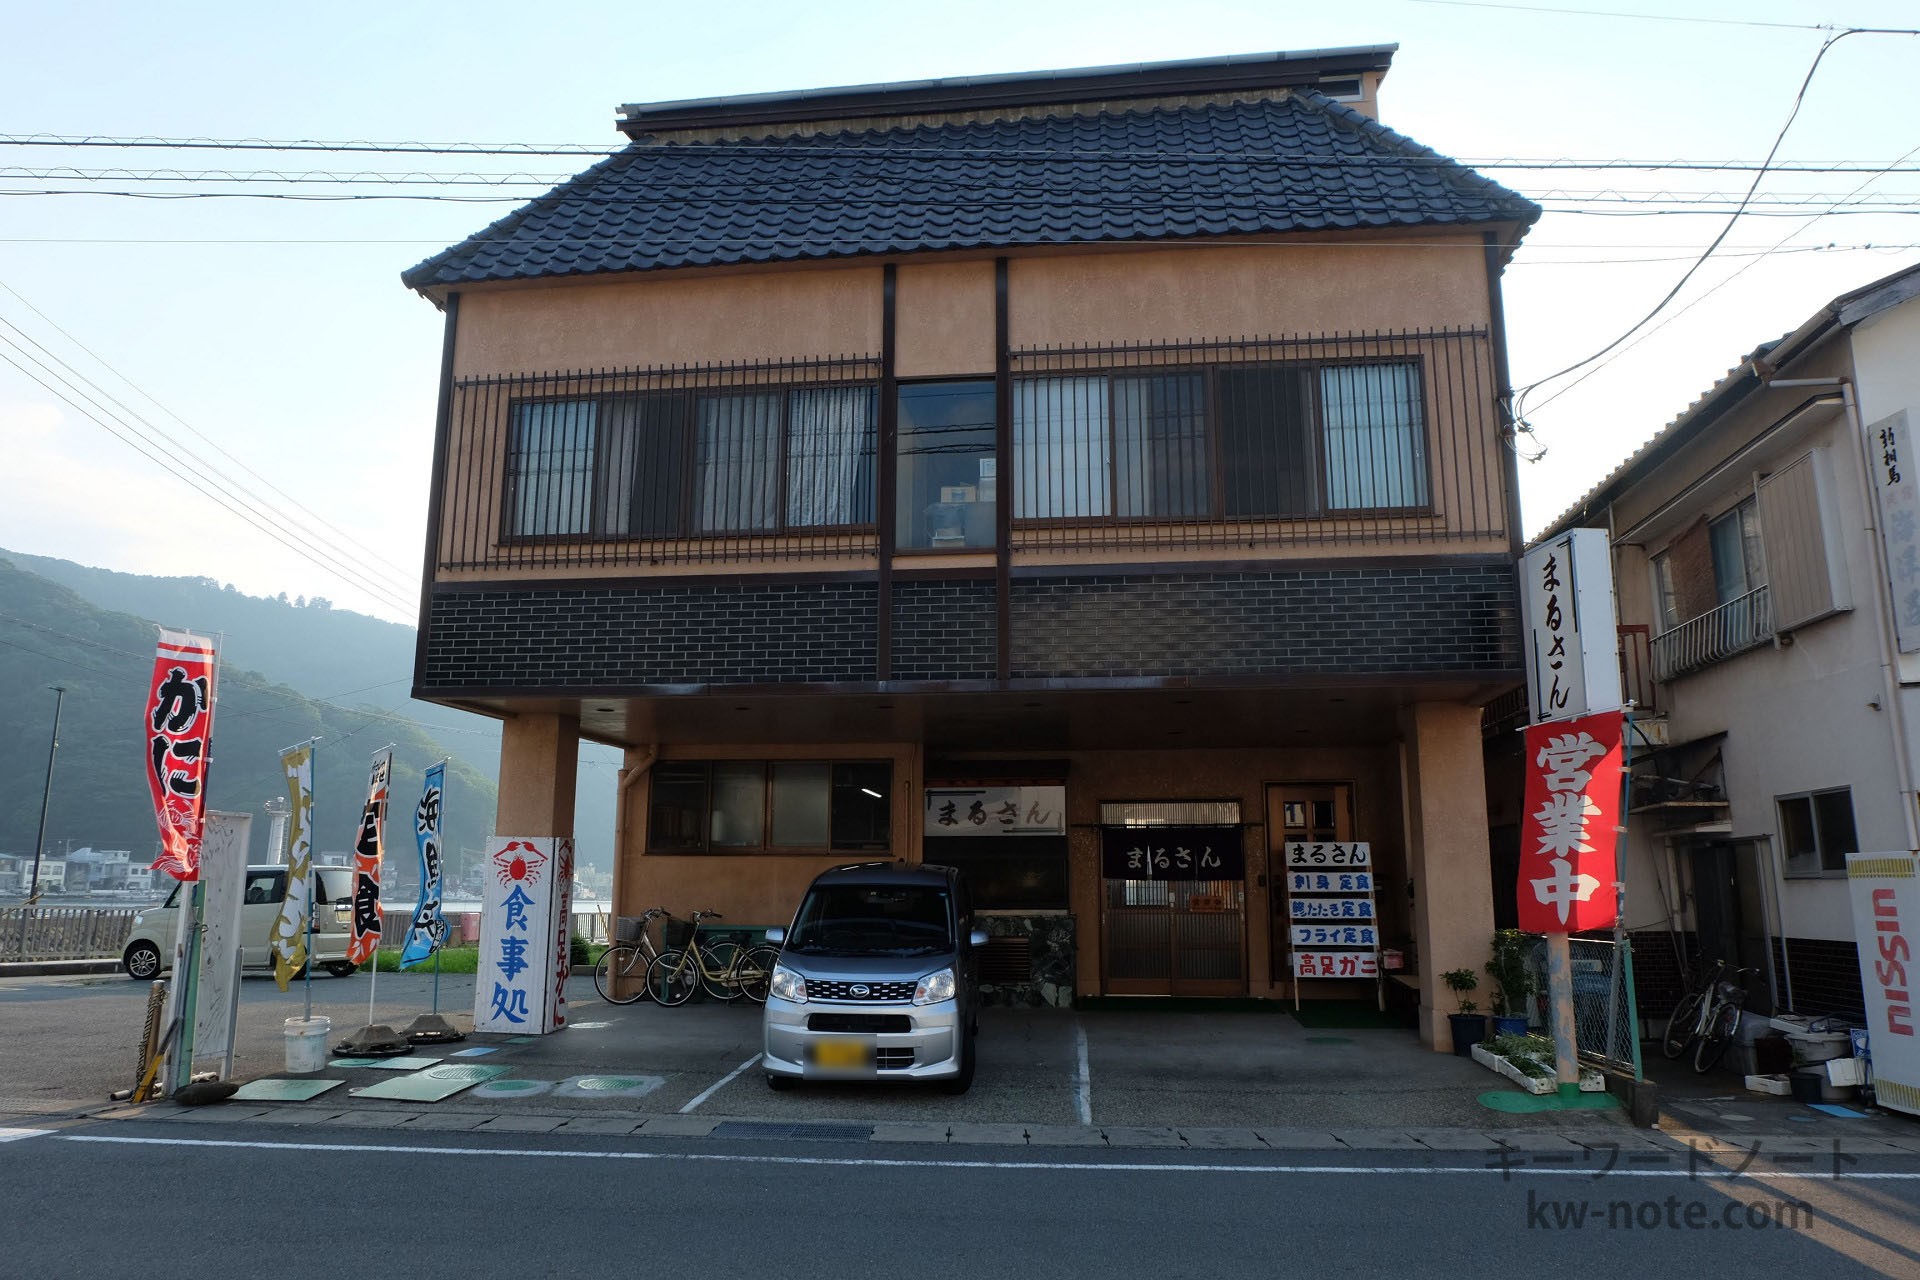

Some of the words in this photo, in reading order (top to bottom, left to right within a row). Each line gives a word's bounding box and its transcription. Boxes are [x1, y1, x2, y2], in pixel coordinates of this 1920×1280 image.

[1541, 552, 1571, 711] まるさん
[153, 666, 209, 798] かに
[937, 799, 1050, 826] まるさん
[1529, 731, 1607, 926] 営業中
[1126, 846, 1221, 869] まるさん
[1291, 843, 1367, 865] まるさん
[1294, 874, 1370, 890] 刺身定食
[1299, 927, 1375, 943] フライ定食
[490, 884, 536, 1024] 食事処
[1300, 953, 1378, 976] 高足ガニ
